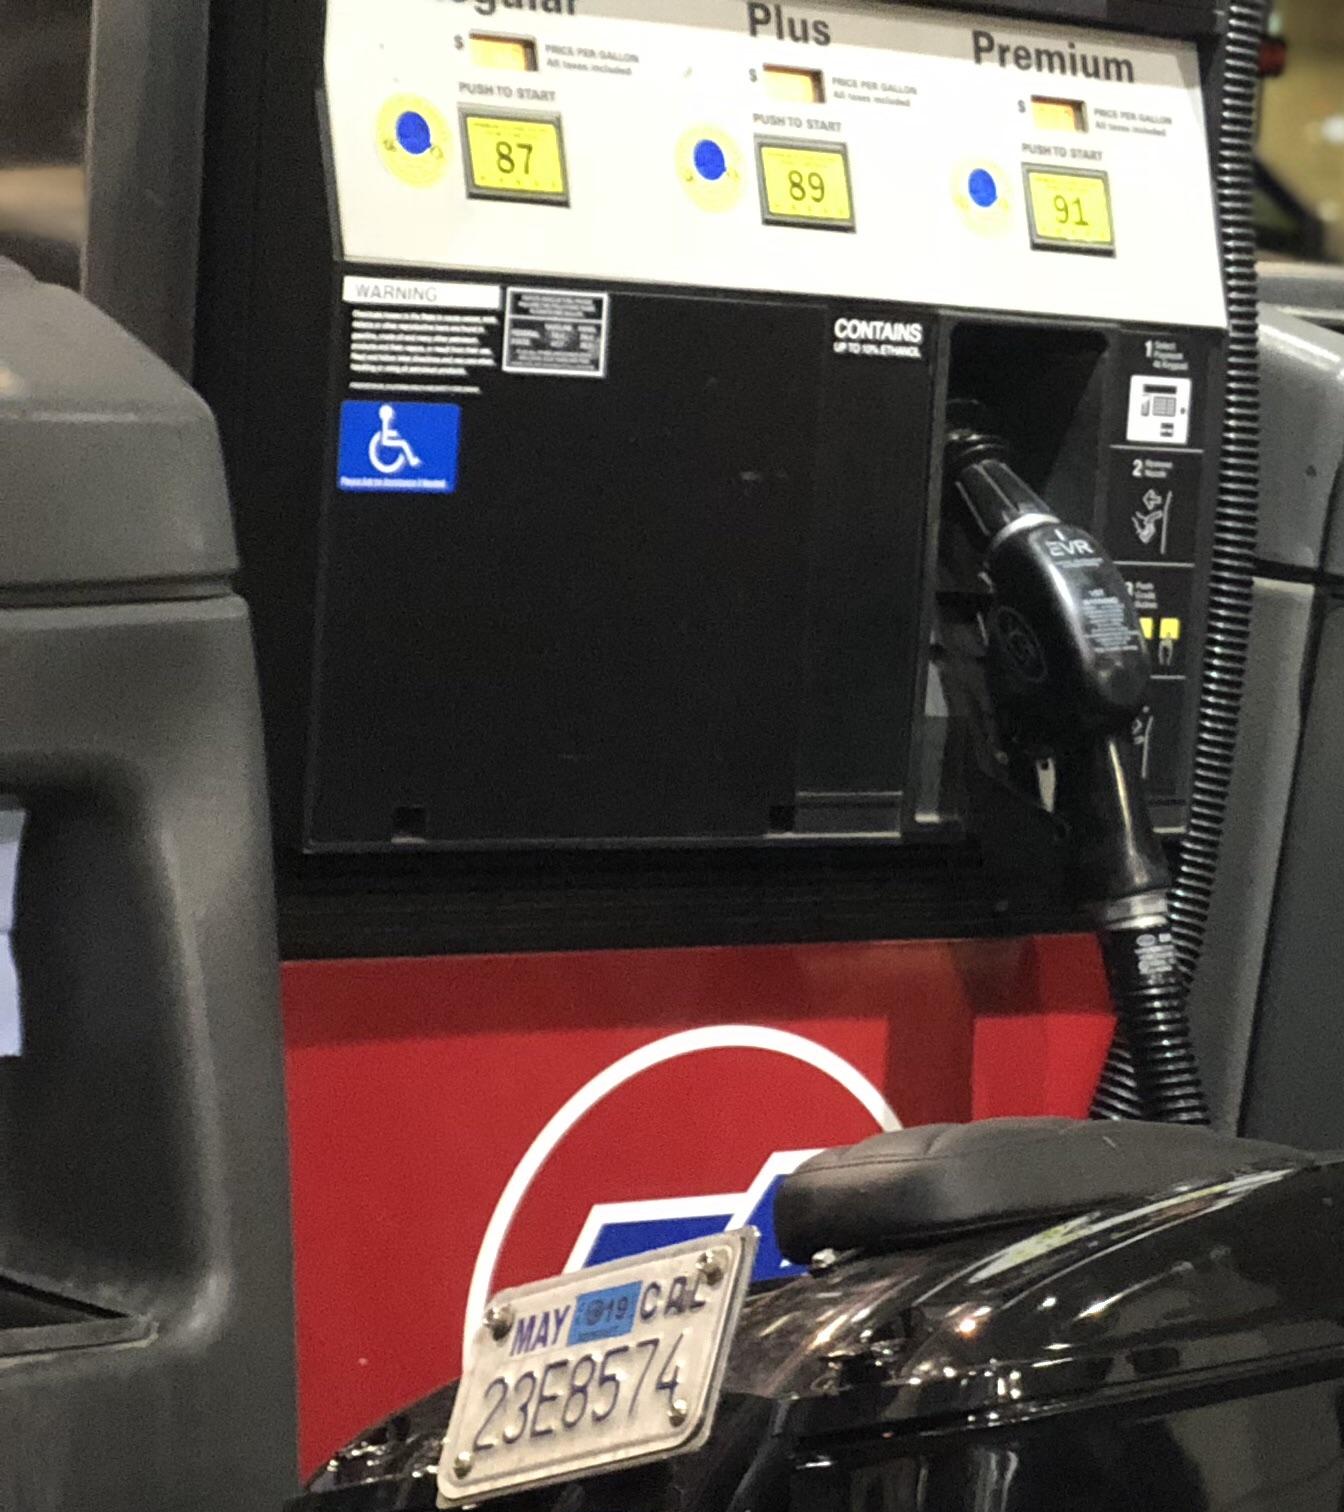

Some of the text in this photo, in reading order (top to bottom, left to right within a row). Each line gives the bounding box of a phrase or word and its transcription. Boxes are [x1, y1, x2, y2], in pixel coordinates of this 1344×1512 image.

[747, 2, 831, 46] Plus
[972, 30, 1135, 83] Premium
[459, 82, 556, 101] PUSH TO START
[753, 113, 842, 132] PUSH TO START
[496, 141, 533, 174] 87
[1022, 143, 1103, 161] PUSH TO START
[788, 170, 824, 203] 89
[1054, 194, 1088, 226] 91
[356, 284, 437, 302] WARNING
[834, 318, 923, 343] CONTAINS
[1145, 340, 1152, 358] 1
[1132, 459, 1143, 477] 2
[1045, 540, 1094, 557] EVR
[510, 1305, 571, 1357] MAY
[472, 1332, 686, 1451] 23E8574
